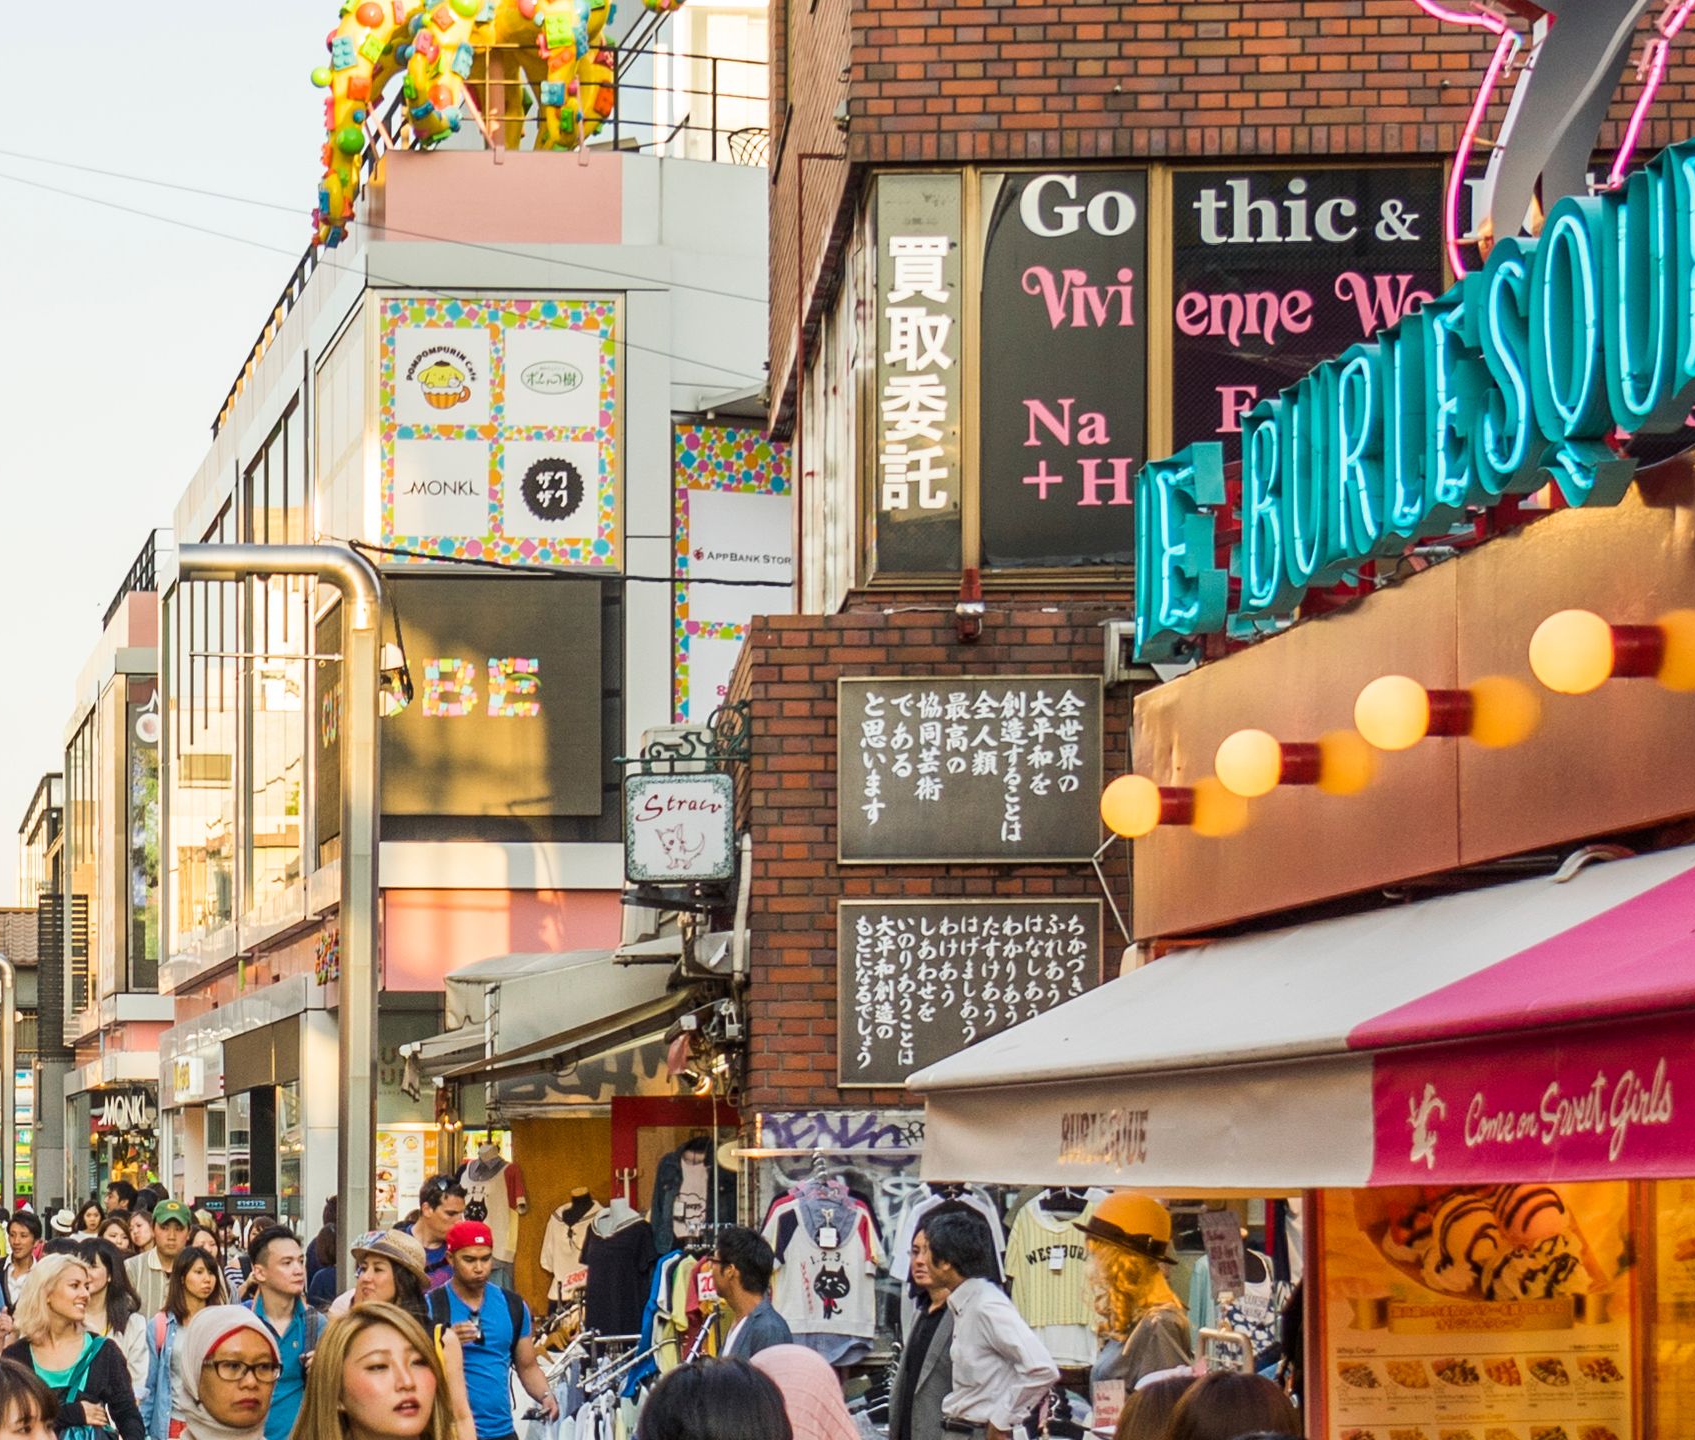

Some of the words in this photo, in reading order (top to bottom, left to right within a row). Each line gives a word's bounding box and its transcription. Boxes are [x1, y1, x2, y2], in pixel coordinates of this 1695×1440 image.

[881, 234, 954, 512] 買取委託
[762, 555, 792, 565] STOR
[859, 692, 887, 827] と思います
[889, 693, 913, 778] である
[943, 692, 971, 775] 最高の
[970, 689, 999, 777] 全人類
[999, 691, 1028, 843] 創造することは
[1026, 691, 1056, 796] 大平和を
[1056, 690, 1086, 794] 全世界の
[874, 915, 897, 1040] 大平和創造の
[938, 916, 959, 1008] わけあう
